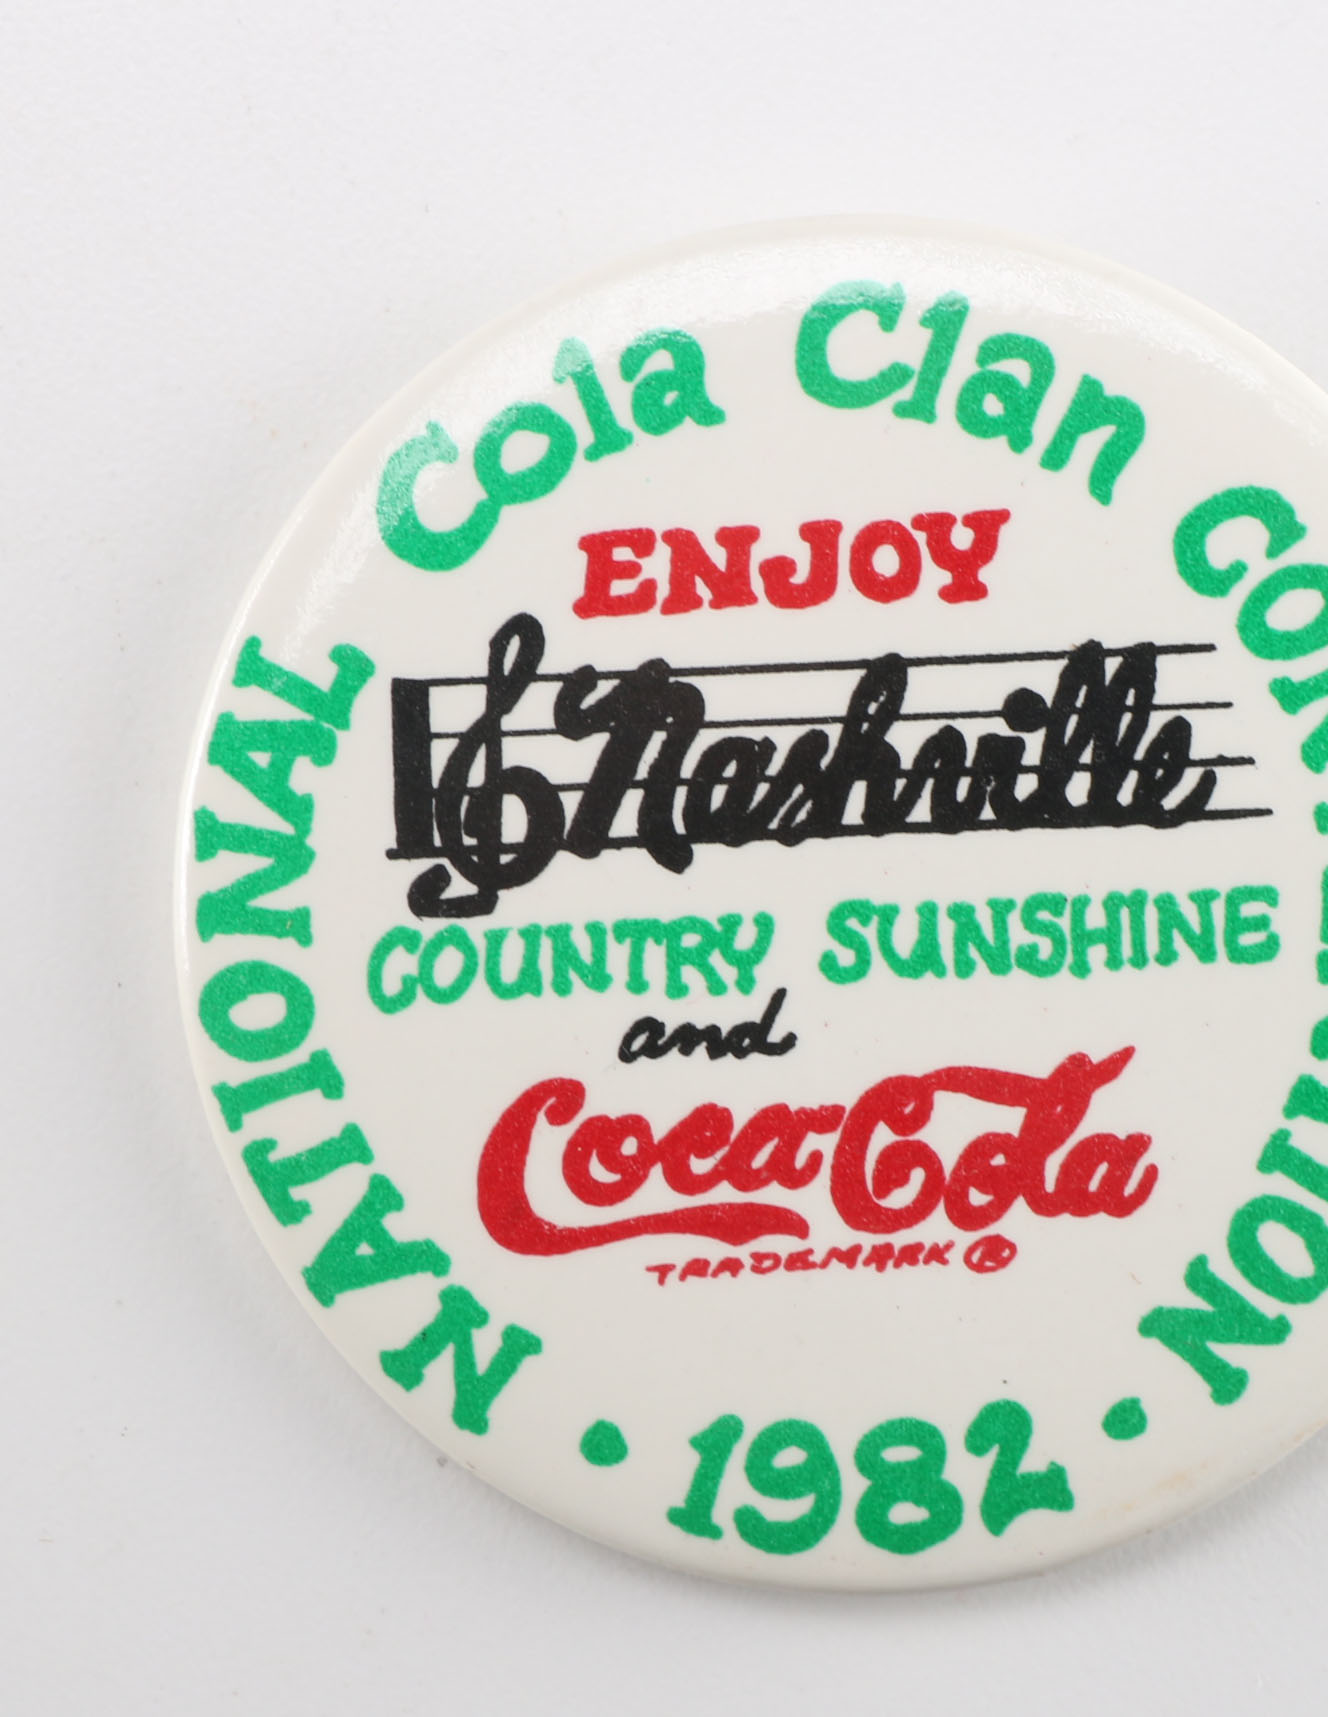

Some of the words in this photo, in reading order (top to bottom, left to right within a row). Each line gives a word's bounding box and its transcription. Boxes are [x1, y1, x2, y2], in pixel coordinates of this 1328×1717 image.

[572, 507, 1012, 621] ENJOY
[552, 639, 1220, 876] Nashville
[194, 635, 545, 1437] NATIONAL
[375, 328, 728, 573] Cola
[794, 278, 1148, 508] Clan
[367, 910, 777, 1016] COUNTRY
[817, 883, 1283, 987] SUNSHINE
[618, 987, 798, 1064] and
[476, 1045, 1160, 1258] Coca-Cola
[645, 1239, 956, 1286] TRADEMARK
[666, 1397, 1076, 1557] 1982
